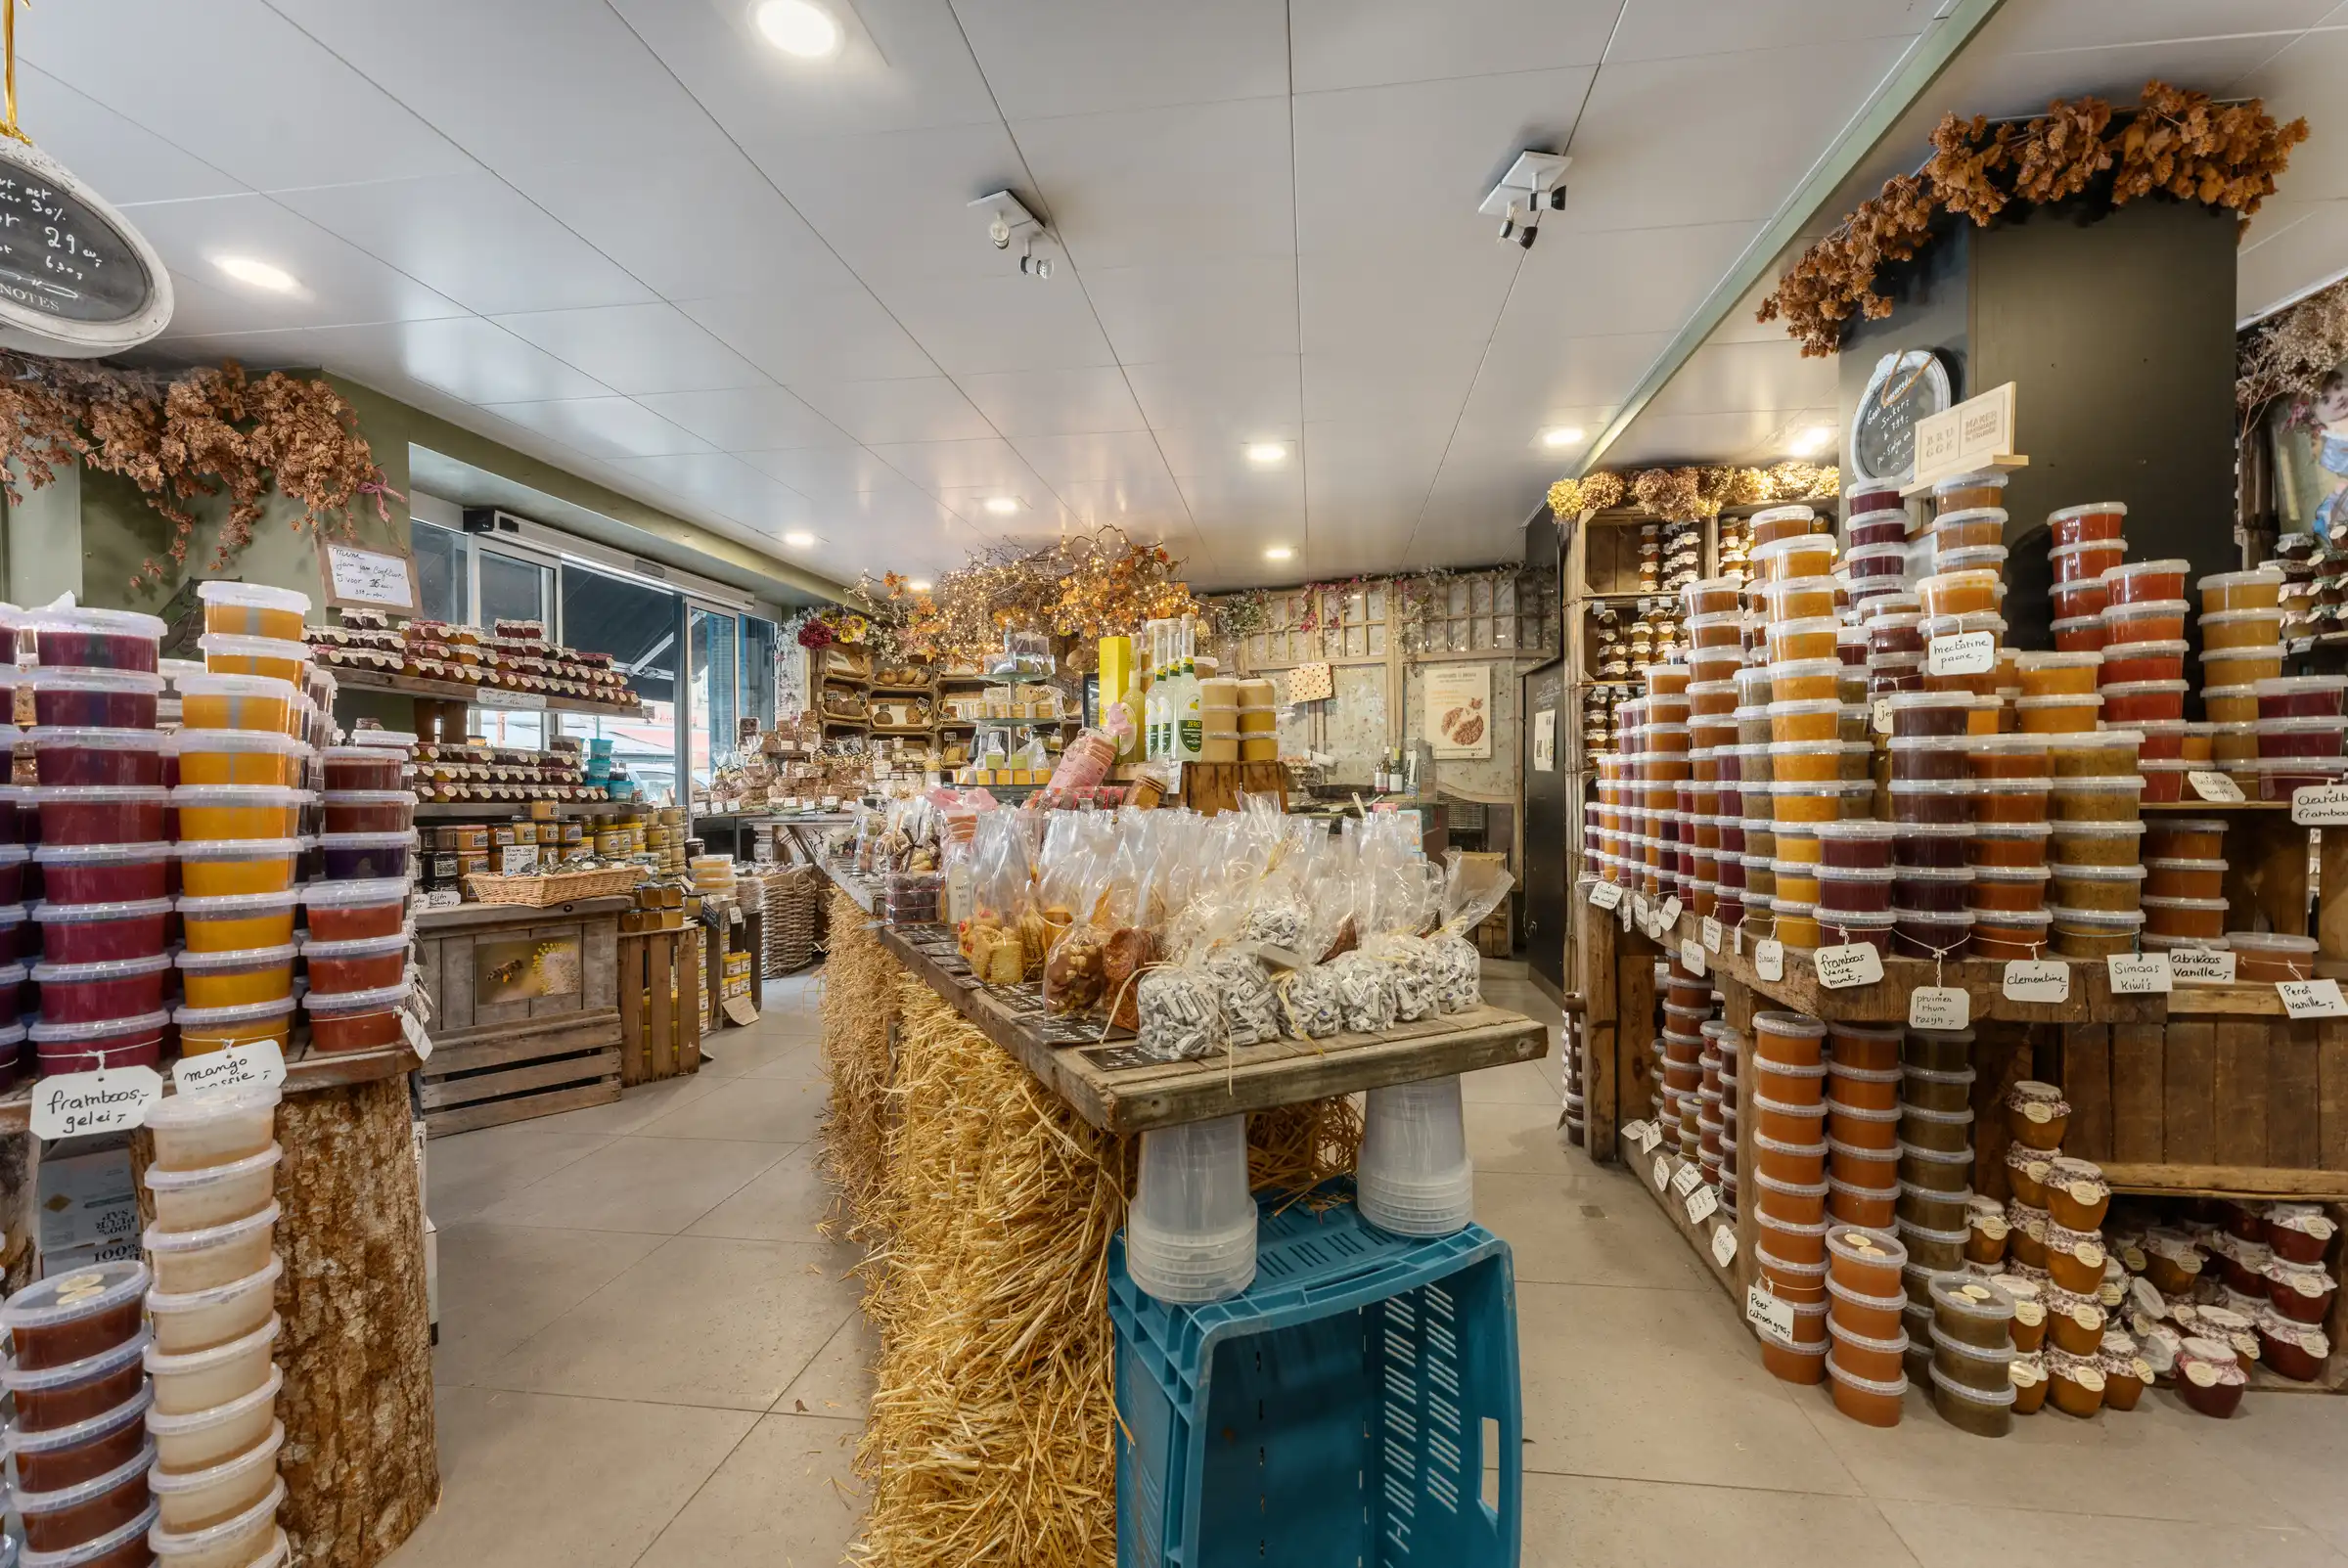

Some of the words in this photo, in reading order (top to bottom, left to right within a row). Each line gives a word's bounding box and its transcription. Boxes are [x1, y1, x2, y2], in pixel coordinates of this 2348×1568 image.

[25, 188, 52, 200] met
[31, 200, 67, 221] 30%
[45, 227, 75, 254] 29
[0, 283, 60, 312] NOTES
[1965, 410, 1998, 428] MAKER
[1821, 953, 1866, 970] framboos
[184, 1057, 248, 1084] mango
[94, 1243, 143, 1264] 100%
